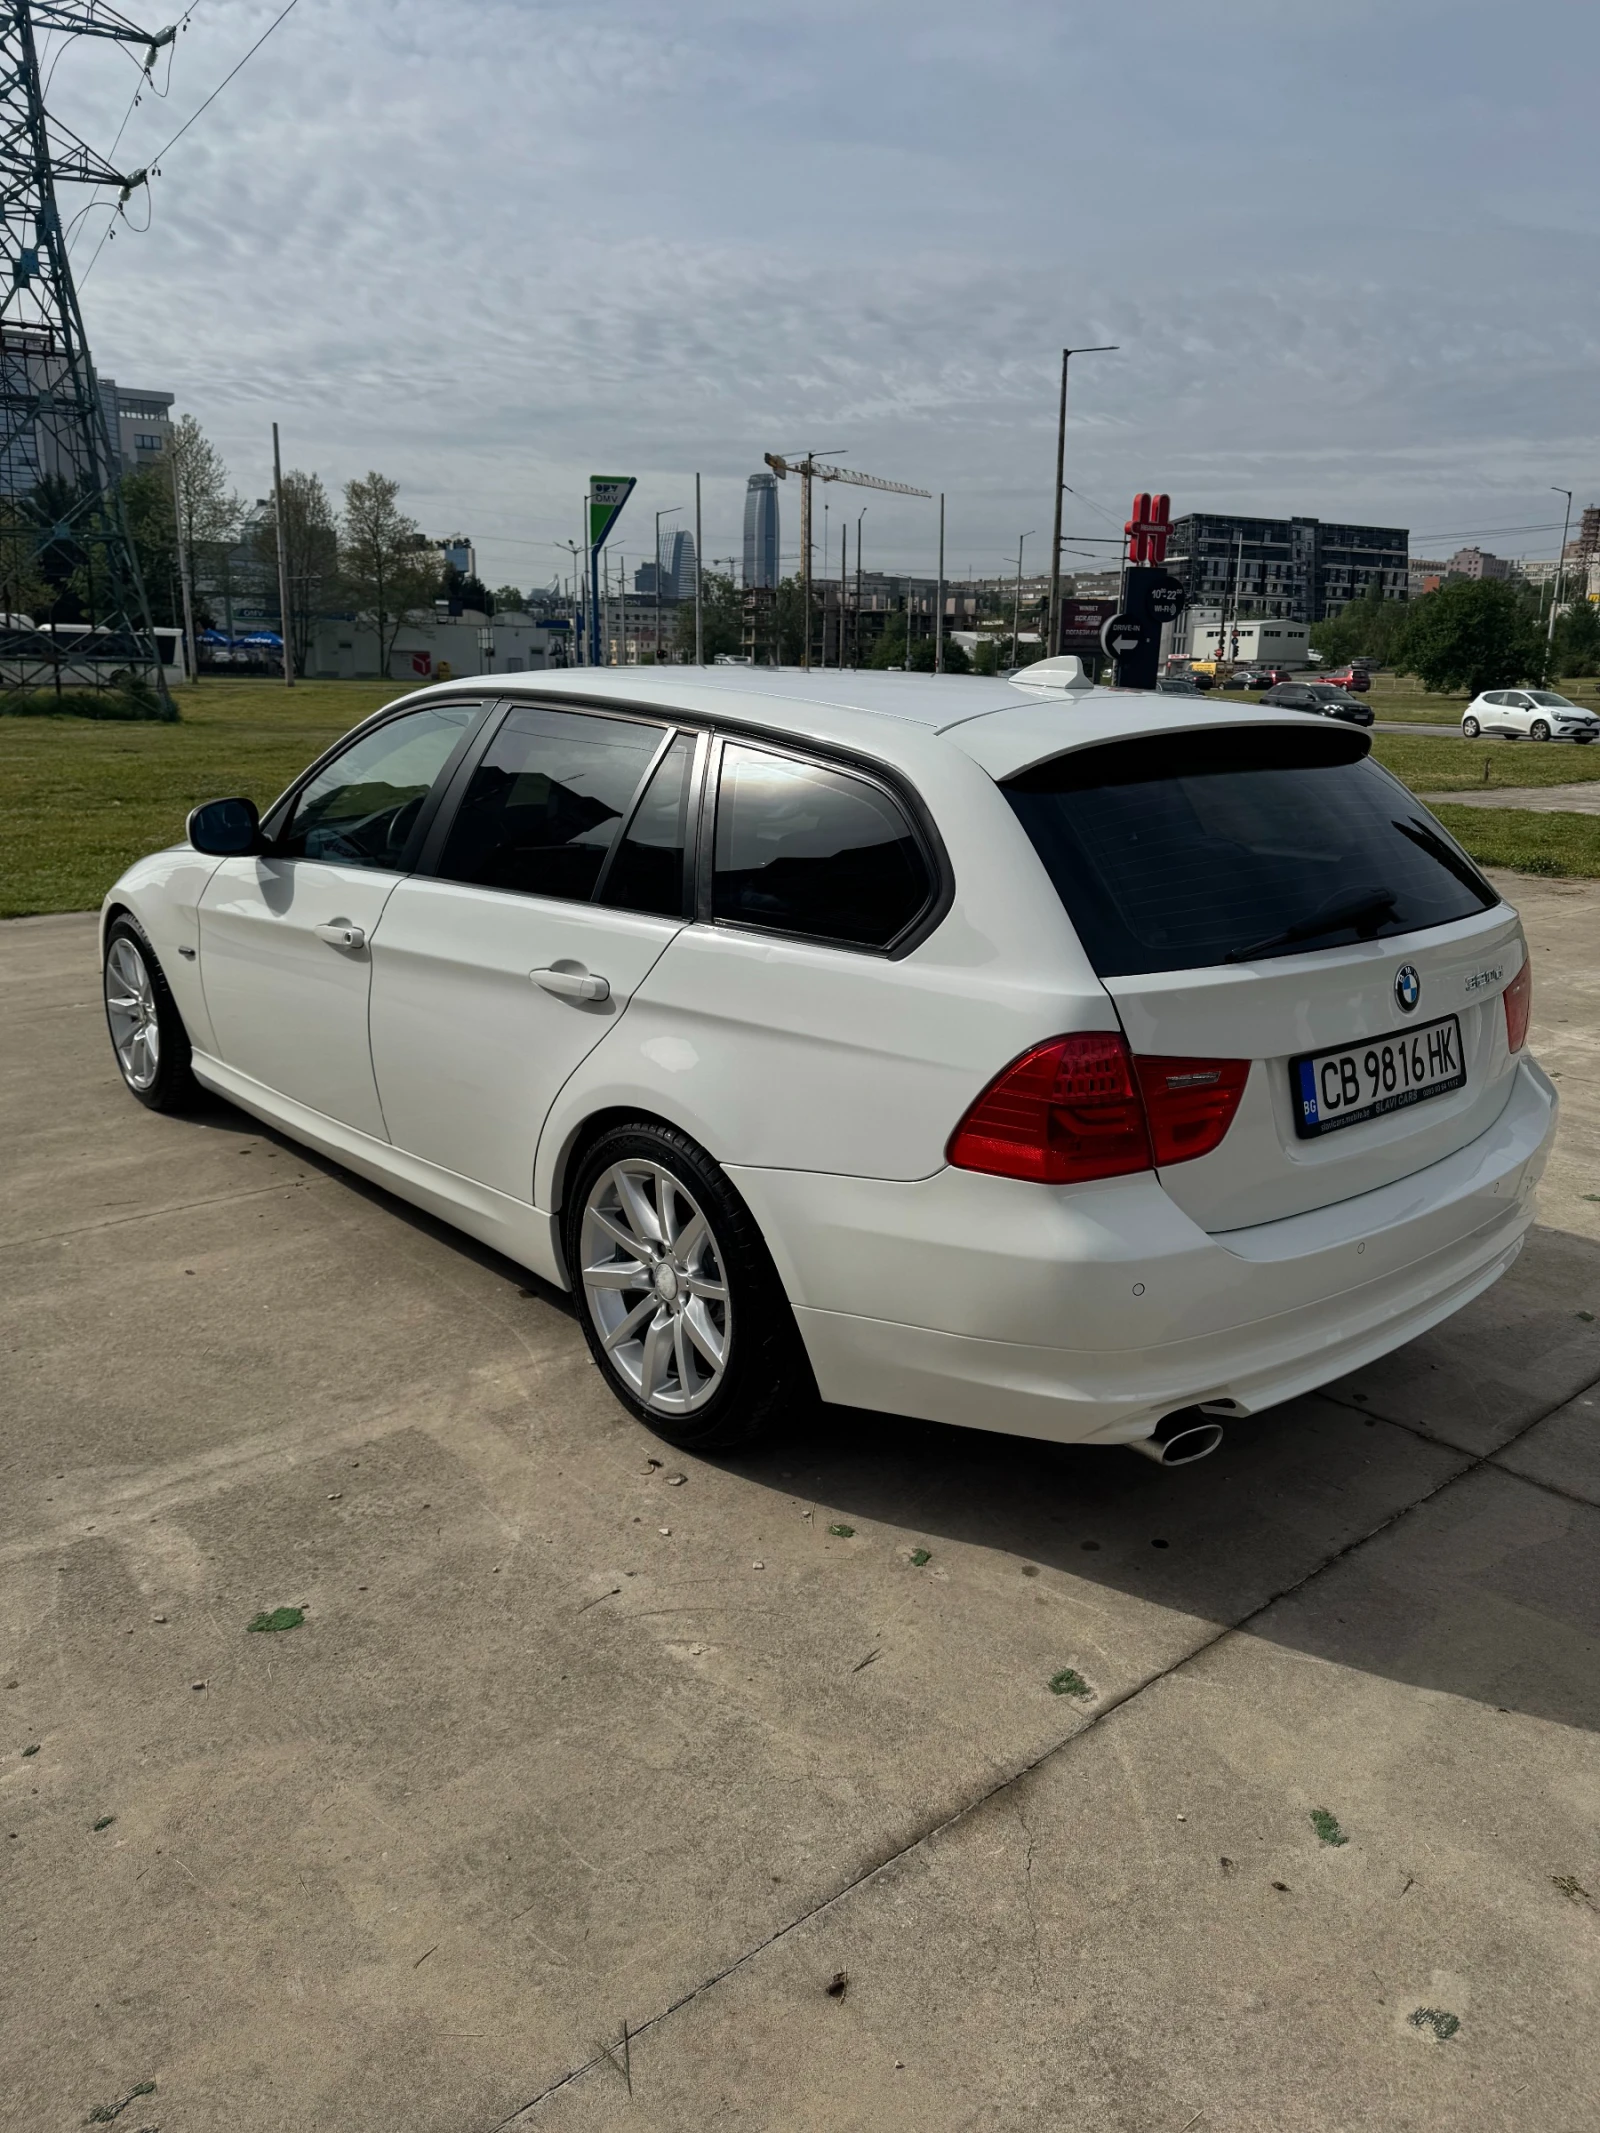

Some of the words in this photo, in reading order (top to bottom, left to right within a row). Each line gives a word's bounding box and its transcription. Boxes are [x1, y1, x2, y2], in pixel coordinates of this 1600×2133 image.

[595, 494, 618, 503] OMV
[243, 609, 263, 617] OMV
[1320, 1056, 1360, 1110] CB
[1364, 1037, 1425, 1098] 9816
[1426, 1026, 1457, 1078] HK
[1303, 1099, 1317, 1115] BG
[1375, 1097, 1398, 1114] SLAVI
[1398, 1090, 1418, 1106] CARS
